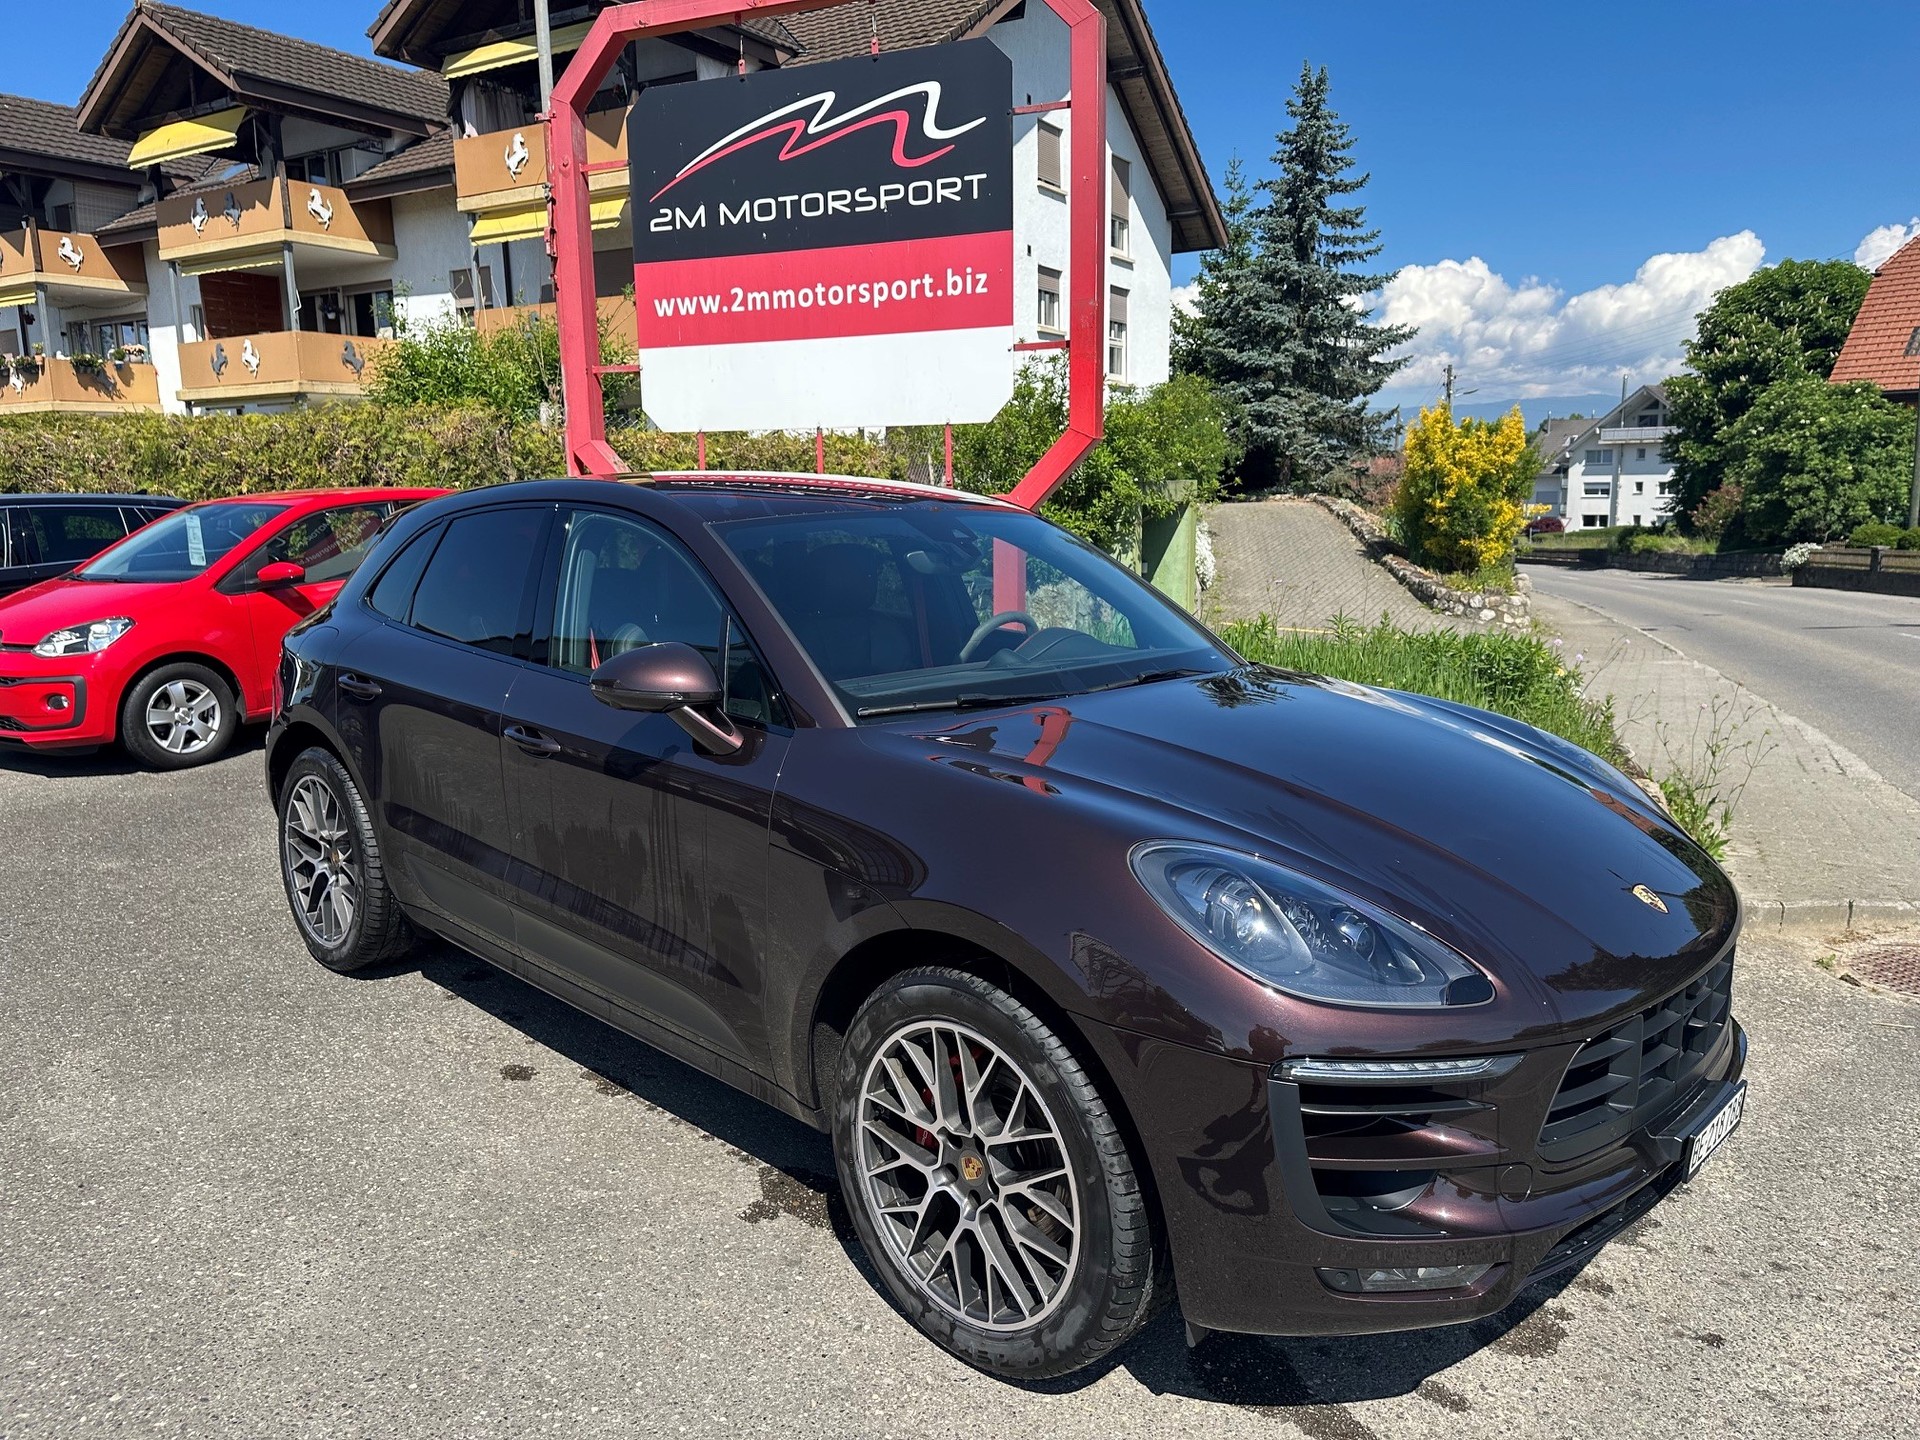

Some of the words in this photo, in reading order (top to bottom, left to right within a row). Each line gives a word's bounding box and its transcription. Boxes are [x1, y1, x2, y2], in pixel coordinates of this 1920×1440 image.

[650, 203, 706, 232] 2M
[719, 174, 987, 226] MOTORSPORT
[653, 266, 988, 318] www.2mmotorsport.biz
